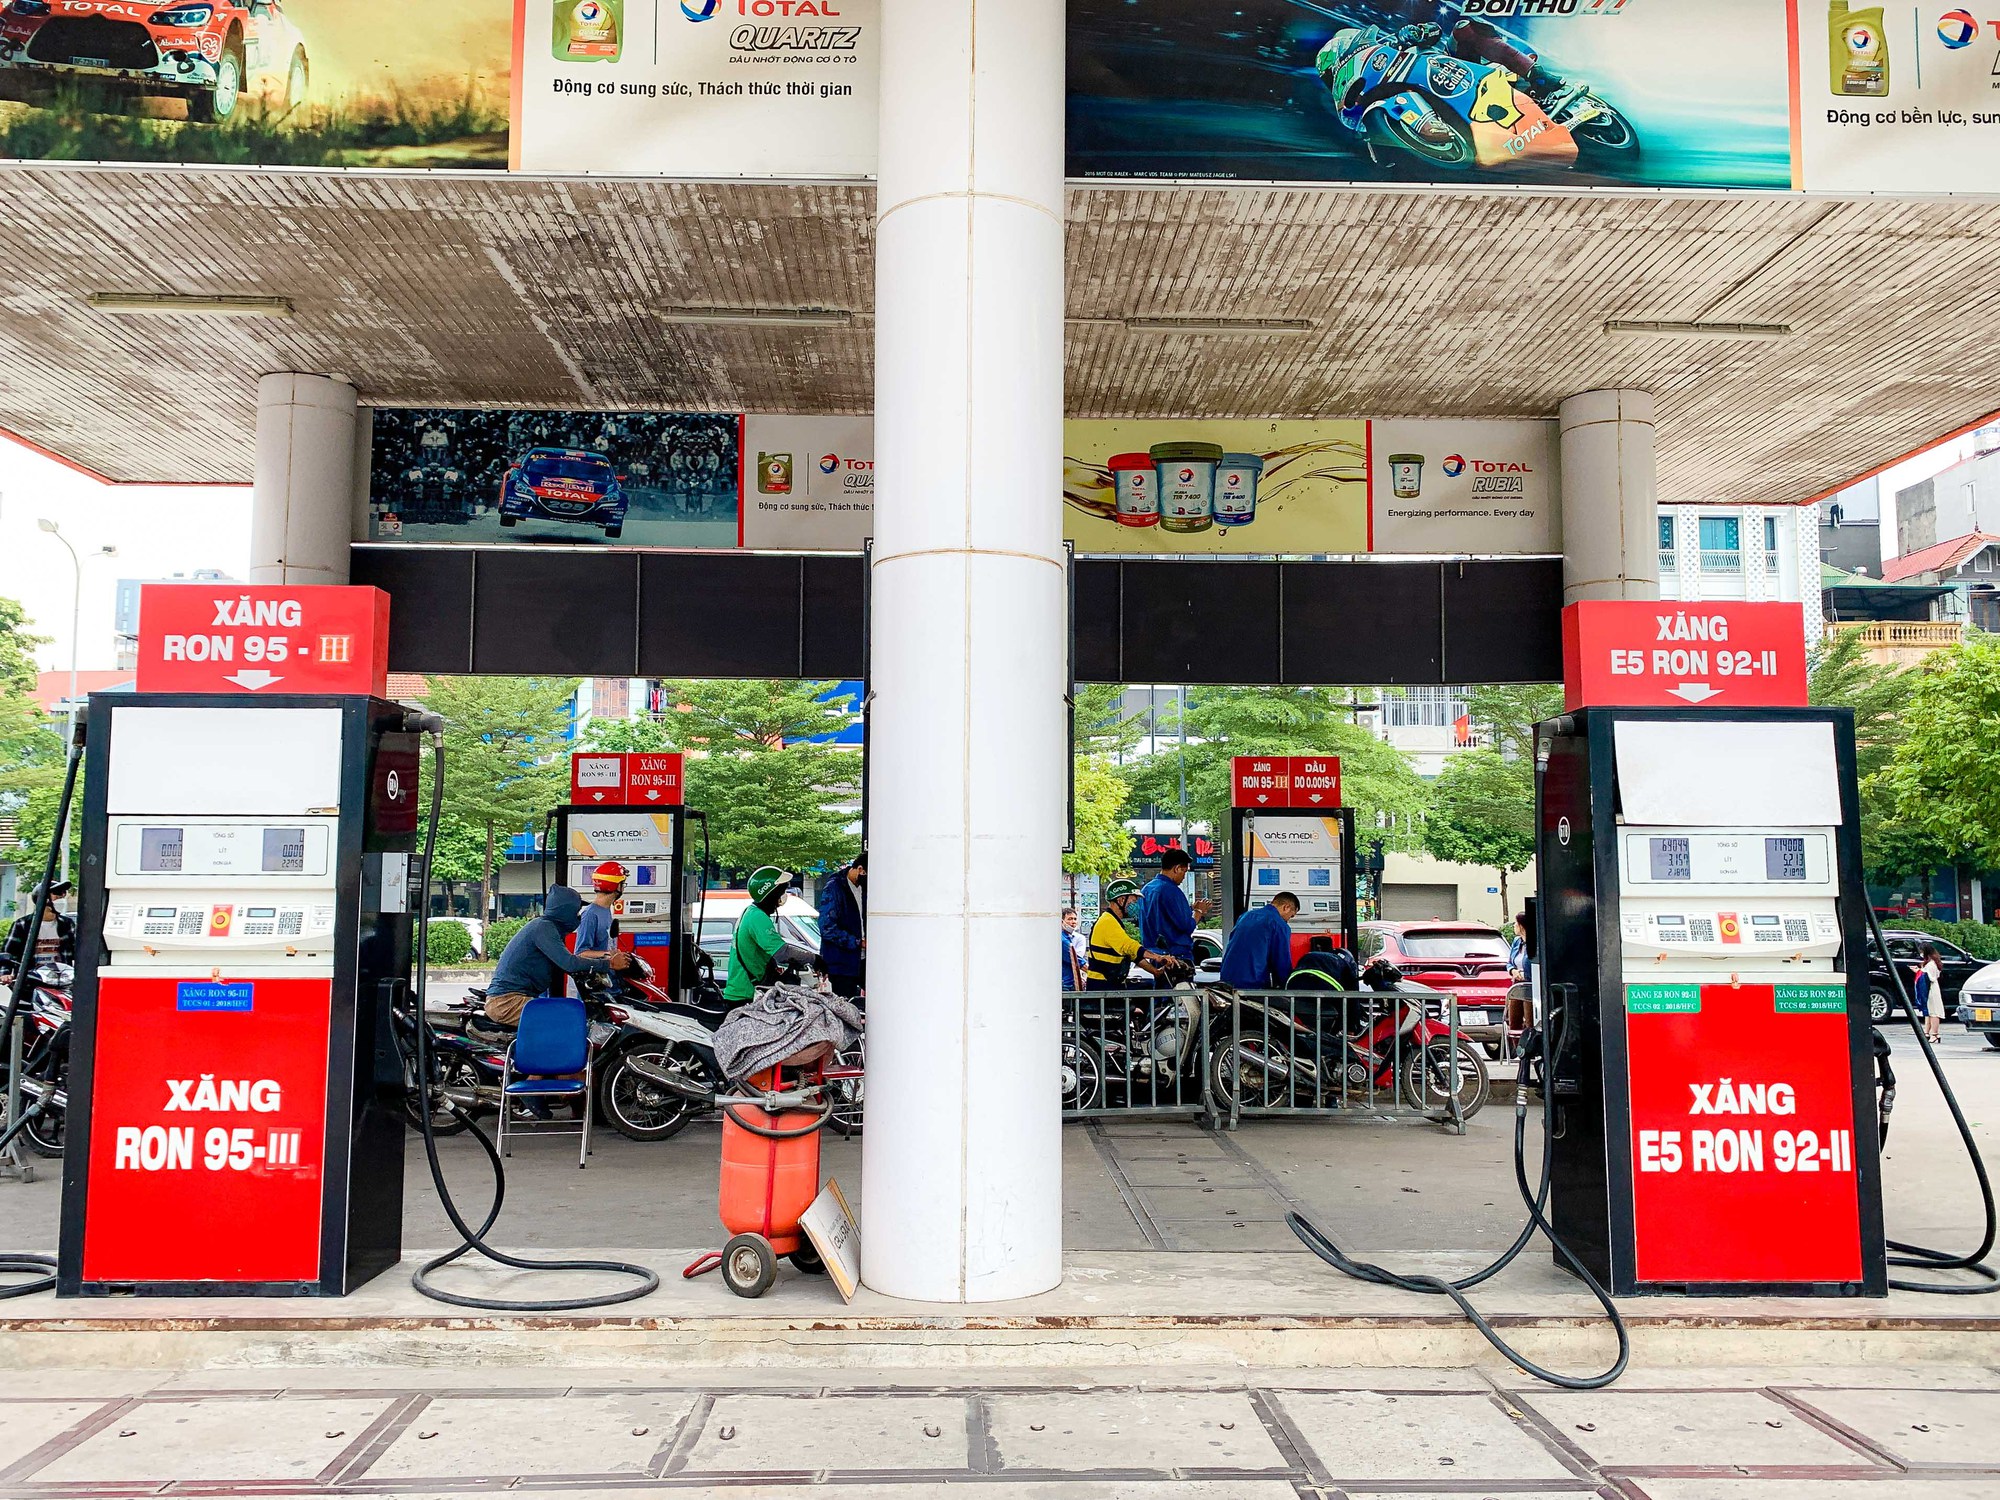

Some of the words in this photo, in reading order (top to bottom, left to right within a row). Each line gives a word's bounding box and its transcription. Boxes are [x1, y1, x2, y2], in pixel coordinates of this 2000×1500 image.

[61, 0, 142, 17] TOTAL
[729, 24, 862, 51] QUARTZ
[553, 78, 592, 97] Động
[597, 81, 616, 95] cơ
[620, 83, 657, 98] sung
[661, 79, 693, 97] sức,
[698, 81, 743, 96] Thách
[748, 80, 782, 96] thức
[786, 79, 816, 96] thời
[820, 82, 852, 99] gian
[1827, 109, 1871, 127] Động
[1875, 110, 1897, 124] cơ
[1901, 106, 1933, 124] bền
[1938, 110, 1967, 127] lực,
[844, 459, 874, 470] TOT
[1470, 460, 1533, 473] TOTAL
[844, 473, 874, 488] QUA
[1472, 476, 1523, 492] RUBIA
[545, 488, 589, 500] TOTAL
[758, 501, 778, 512] Động
[791, 503, 809, 512] sung
[828, 502, 851, 511] Thách
[1388, 509, 1432, 518] Energizing
[1434, 509, 1491, 518] performance.
[1494, 509, 1517, 518] Every
[1519, 509, 1535, 518] day
[211, 595, 302, 627] XĂNG
[1656, 610, 1729, 642] XĂNG
[163, 635, 233, 662] RON
[244, 636, 288, 663] 95
[1611, 650, 1645, 676] E5
[1652, 649, 1709, 676] RON
[1716, 650, 1777, 676] 92-II
[640, 757, 667, 771] XĂNG
[1253, 761, 1271, 772] XĂNG
[1305, 760, 1326, 773] DẦU
[631, 774, 652, 786] RON
[653, 774, 676, 786] 95-III
[1242, 775, 1260, 789] RON
[1294, 776, 1305, 789] DO
[1306, 775, 1336, 789] 0.001S-V
[592, 829, 616, 838] ants
[1264, 831, 1287, 840] ants
[757, 881, 772, 895] Grab
[182, 987, 206, 998] XĂNG
[208, 989, 227, 998] RON
[227, 989, 249, 998] 95-III
[1631, 989, 1652, 999] XĂNG
[1653, 990, 1663, 999] E5
[1664, 990, 1680, 999] RON
[1681, 990, 1697, 999] 92-II
[1776, 988, 1798, 999] XĂNG
[1799, 989, 1809, 998] E5
[1810, 990, 1826, 998] RON
[1827, 990, 1844, 998] 92-II
[163, 1073, 282, 1113] XĂNG
[1688, 1077, 1796, 1116] XĂNG
[114, 1126, 194, 1171] RON
[204, 1127, 299, 1171] 95-III
[1639, 1130, 1683, 1173] E5
[1692, 1128, 1764, 1173] RON
[1773, 1129, 1852, 1173] 92-II
